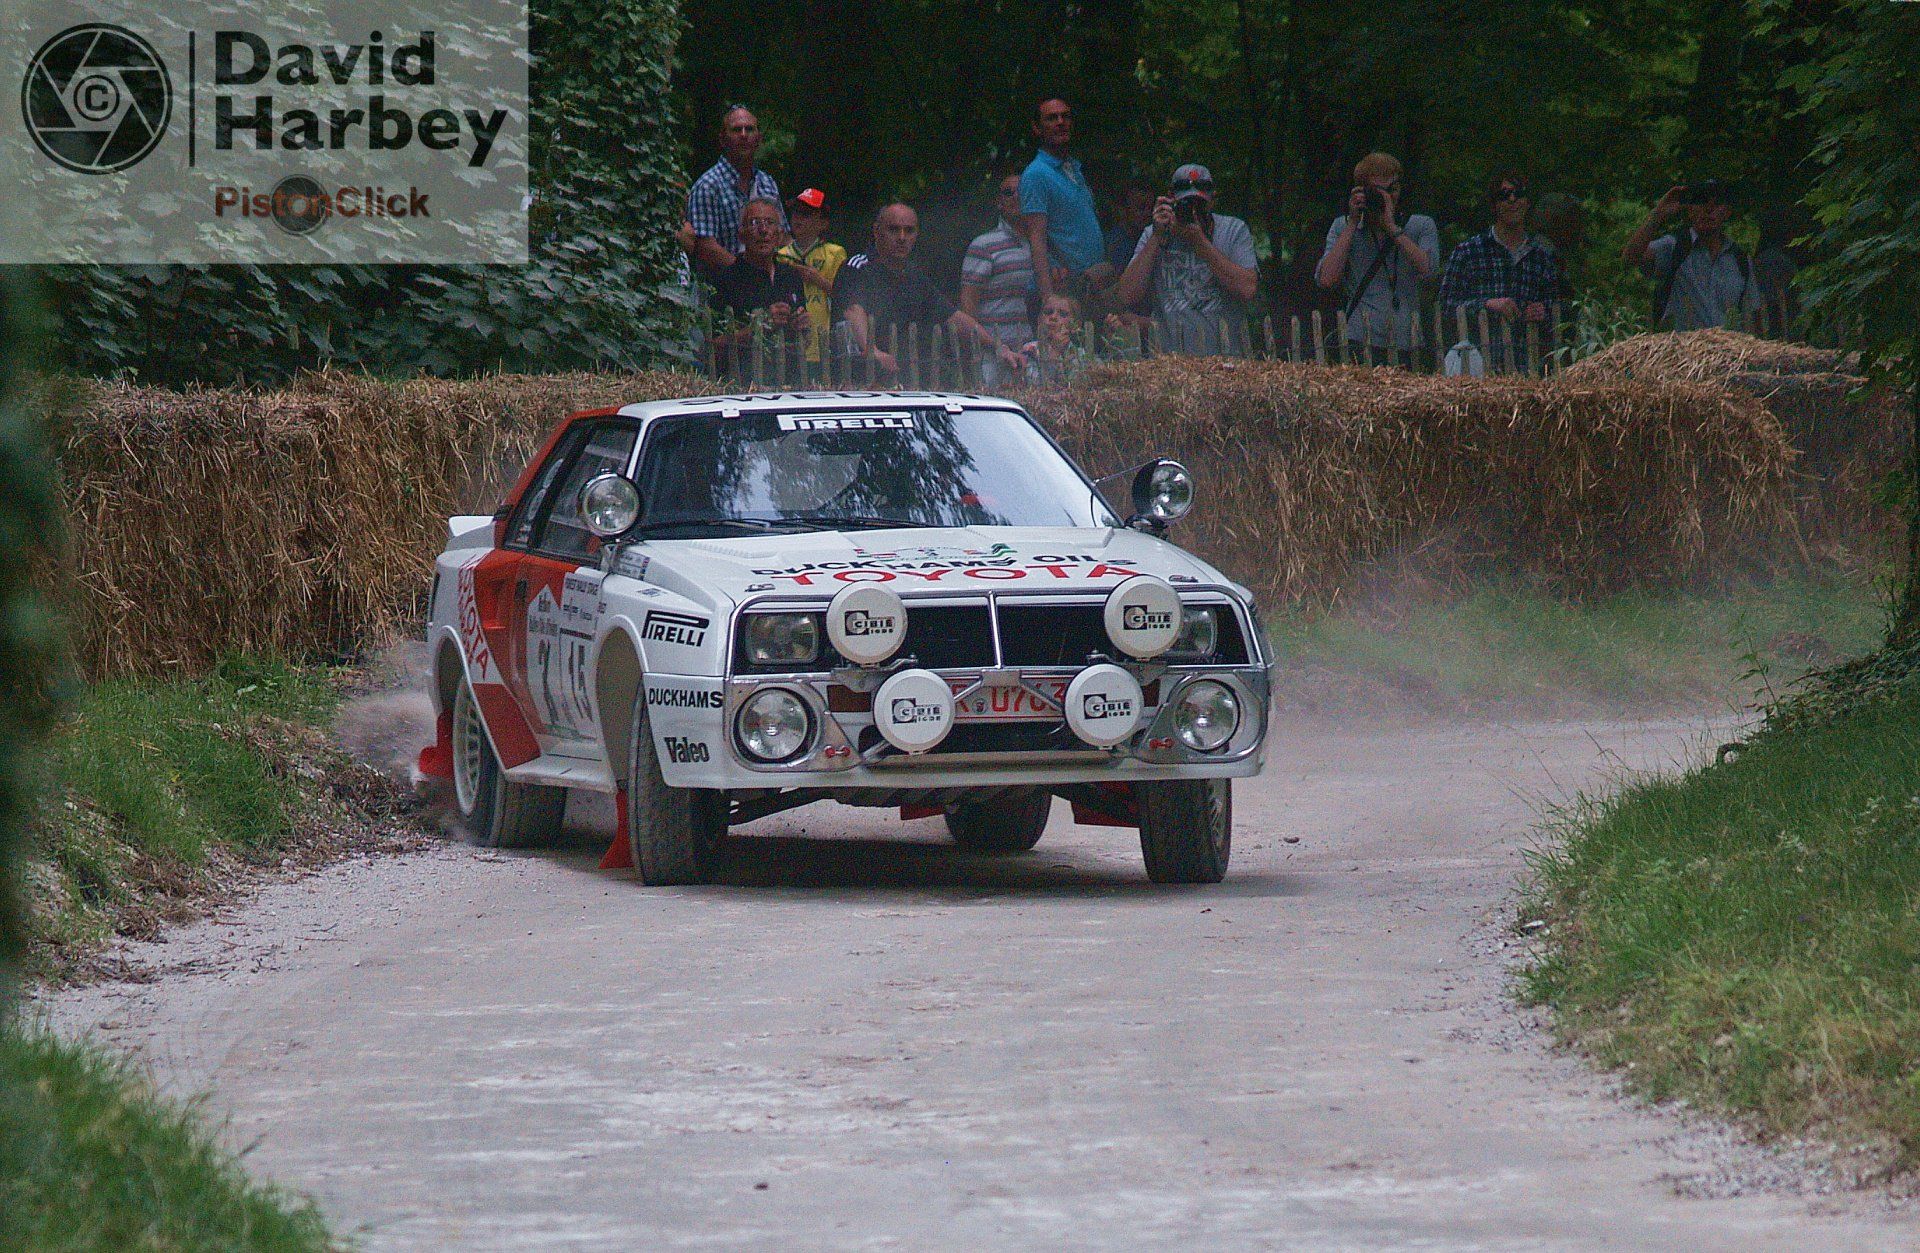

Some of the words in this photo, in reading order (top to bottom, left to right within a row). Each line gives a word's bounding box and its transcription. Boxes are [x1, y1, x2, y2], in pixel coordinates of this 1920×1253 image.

[777, 411, 914, 431] PIRELLI
[751, 556, 1017, 574] DUCKHAMS
[1032, 555, 1137, 566] OILS
[770, 564, 1141, 586] TOYOTA
[641, 610, 710, 647] PIRELLI
[648, 688, 723, 709] DUCKHAMS
[664, 737, 710, 763] Valeo
